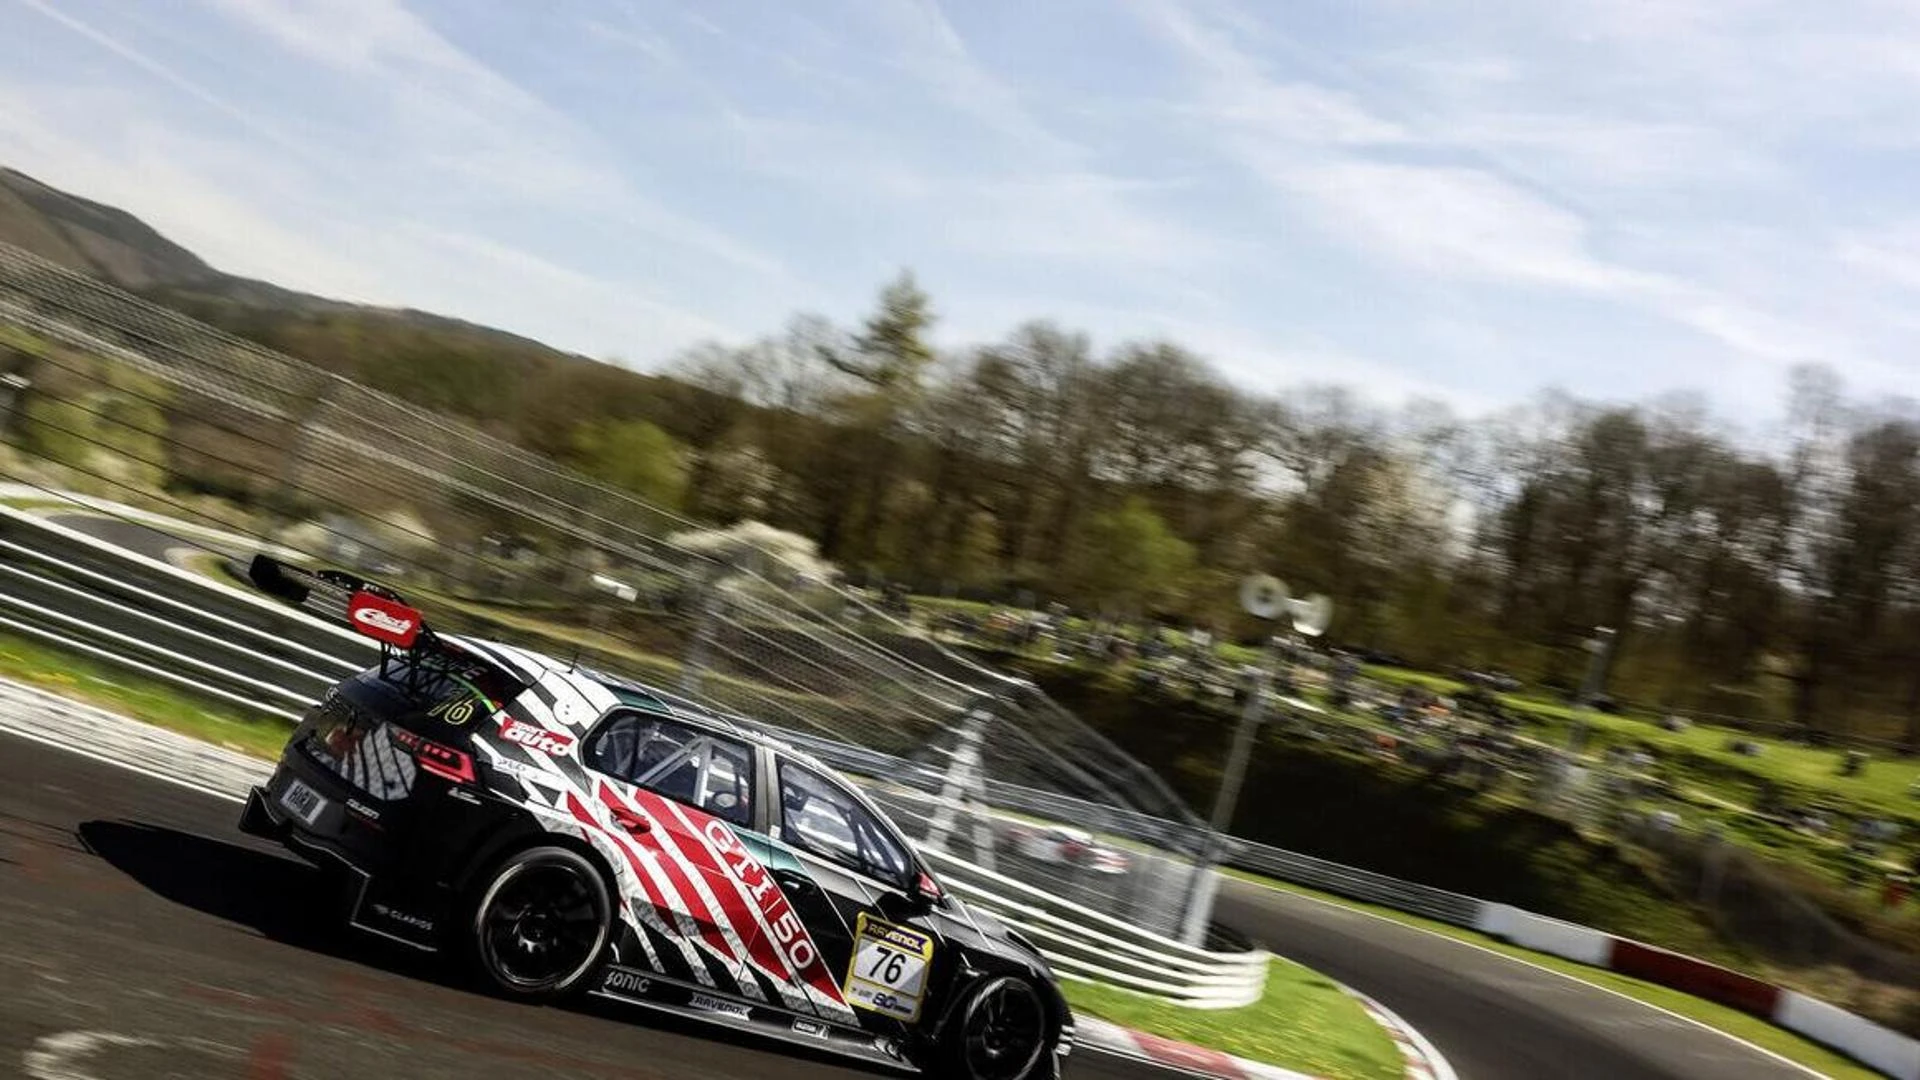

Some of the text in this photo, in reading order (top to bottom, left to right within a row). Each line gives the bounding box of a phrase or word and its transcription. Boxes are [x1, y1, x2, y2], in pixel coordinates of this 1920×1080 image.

[503, 727, 570, 757] auto
[705, 820, 775, 901] GTI
[773, 911, 815, 970] 50
[867, 922, 923, 951] RAVENOL
[869, 946, 907, 985] 76
[694, 995, 747, 1016] RAVENOL
